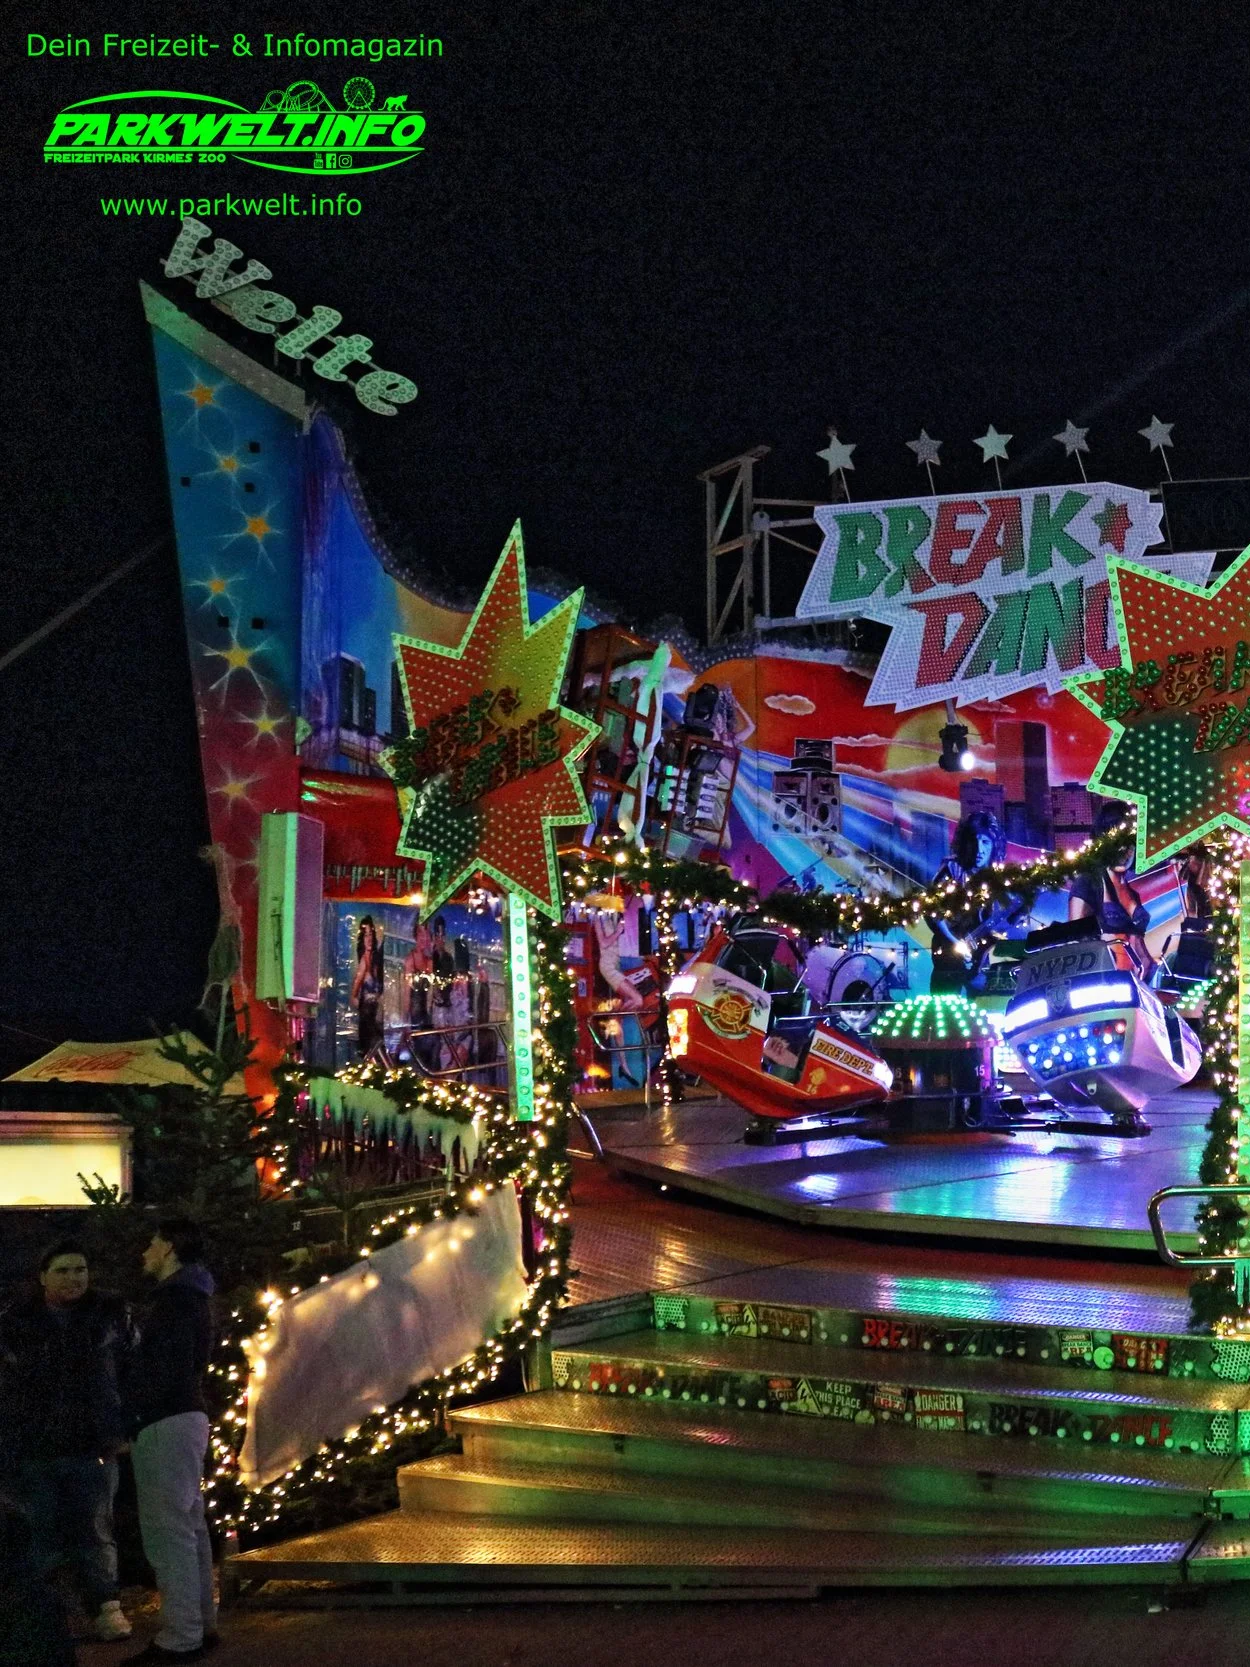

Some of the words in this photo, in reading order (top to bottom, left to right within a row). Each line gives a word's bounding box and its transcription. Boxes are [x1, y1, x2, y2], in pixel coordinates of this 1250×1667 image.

[164, 217, 418, 416] Welte
[828, 490, 1095, 602] BREAK
[905, 575, 1122, 688] DANC
[1027, 952, 1097, 988] NYPD
[812, 1038, 844, 1060] FIRE
[826, 1381, 852, 1394] KEEP
[835, 1395, 861, 1409] PLACE
[921, 1394, 956, 1411] DANGER
